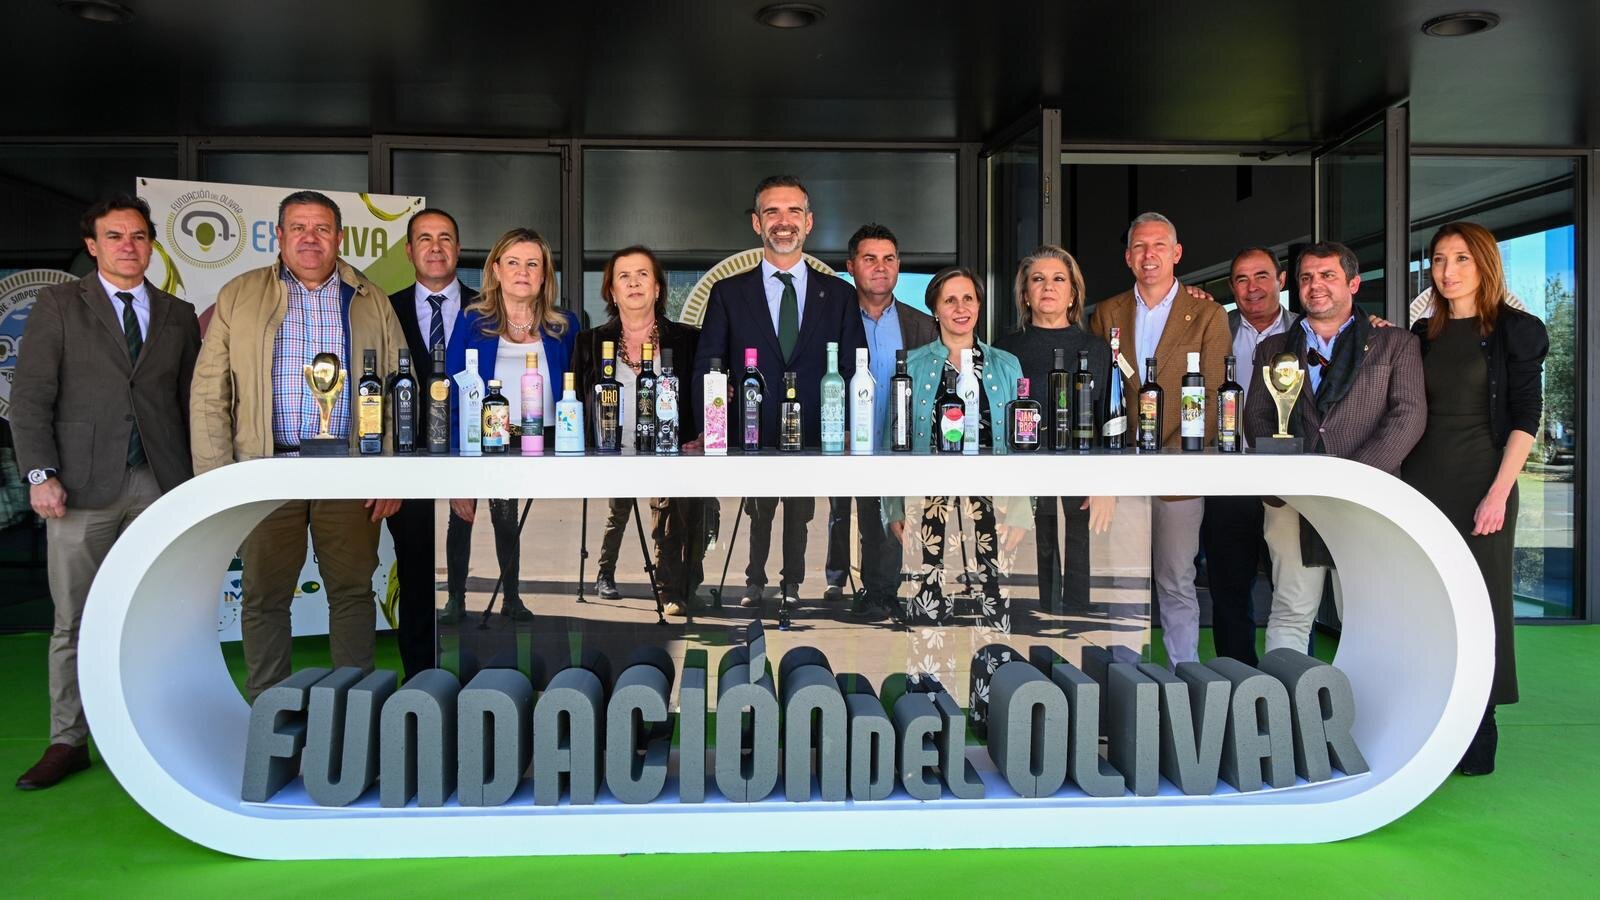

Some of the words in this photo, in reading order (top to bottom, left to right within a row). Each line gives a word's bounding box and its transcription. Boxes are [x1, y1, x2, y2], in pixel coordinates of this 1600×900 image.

[601, 390, 618, 403] ORO
[241, 642, 846, 807] FUNDACIÓN
[850, 713, 985, 803] DEL
[1003, 663, 1372, 799] OLIVAR
